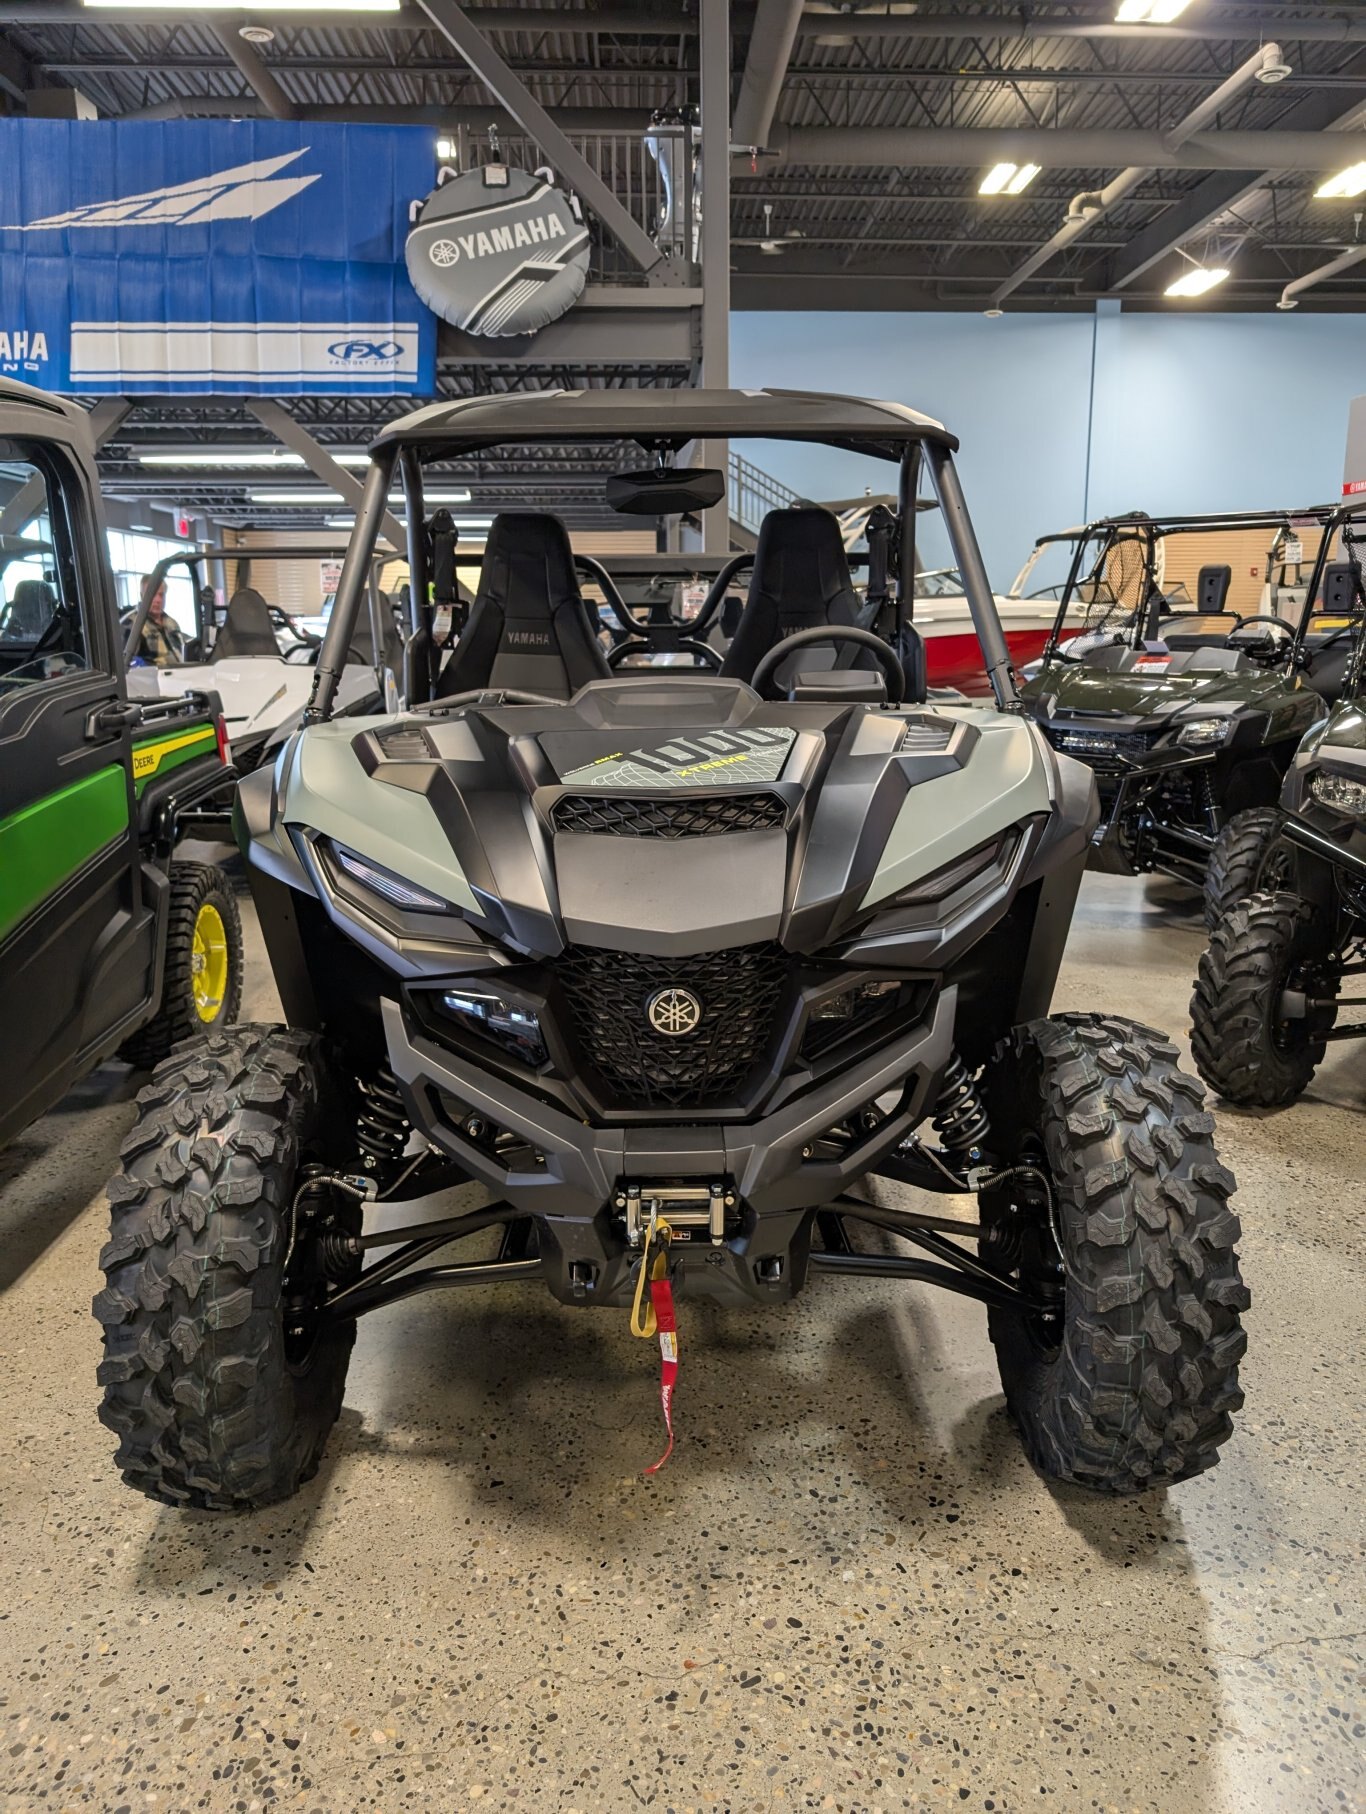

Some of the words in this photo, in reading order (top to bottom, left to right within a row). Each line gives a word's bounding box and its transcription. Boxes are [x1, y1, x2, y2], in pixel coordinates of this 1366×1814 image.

[458, 213, 567, 259] YAMAHA
[508, 632, 550, 645] YAMAHA
[134, 755, 154, 769] DEERE
[613, 728, 790, 774] 1000
